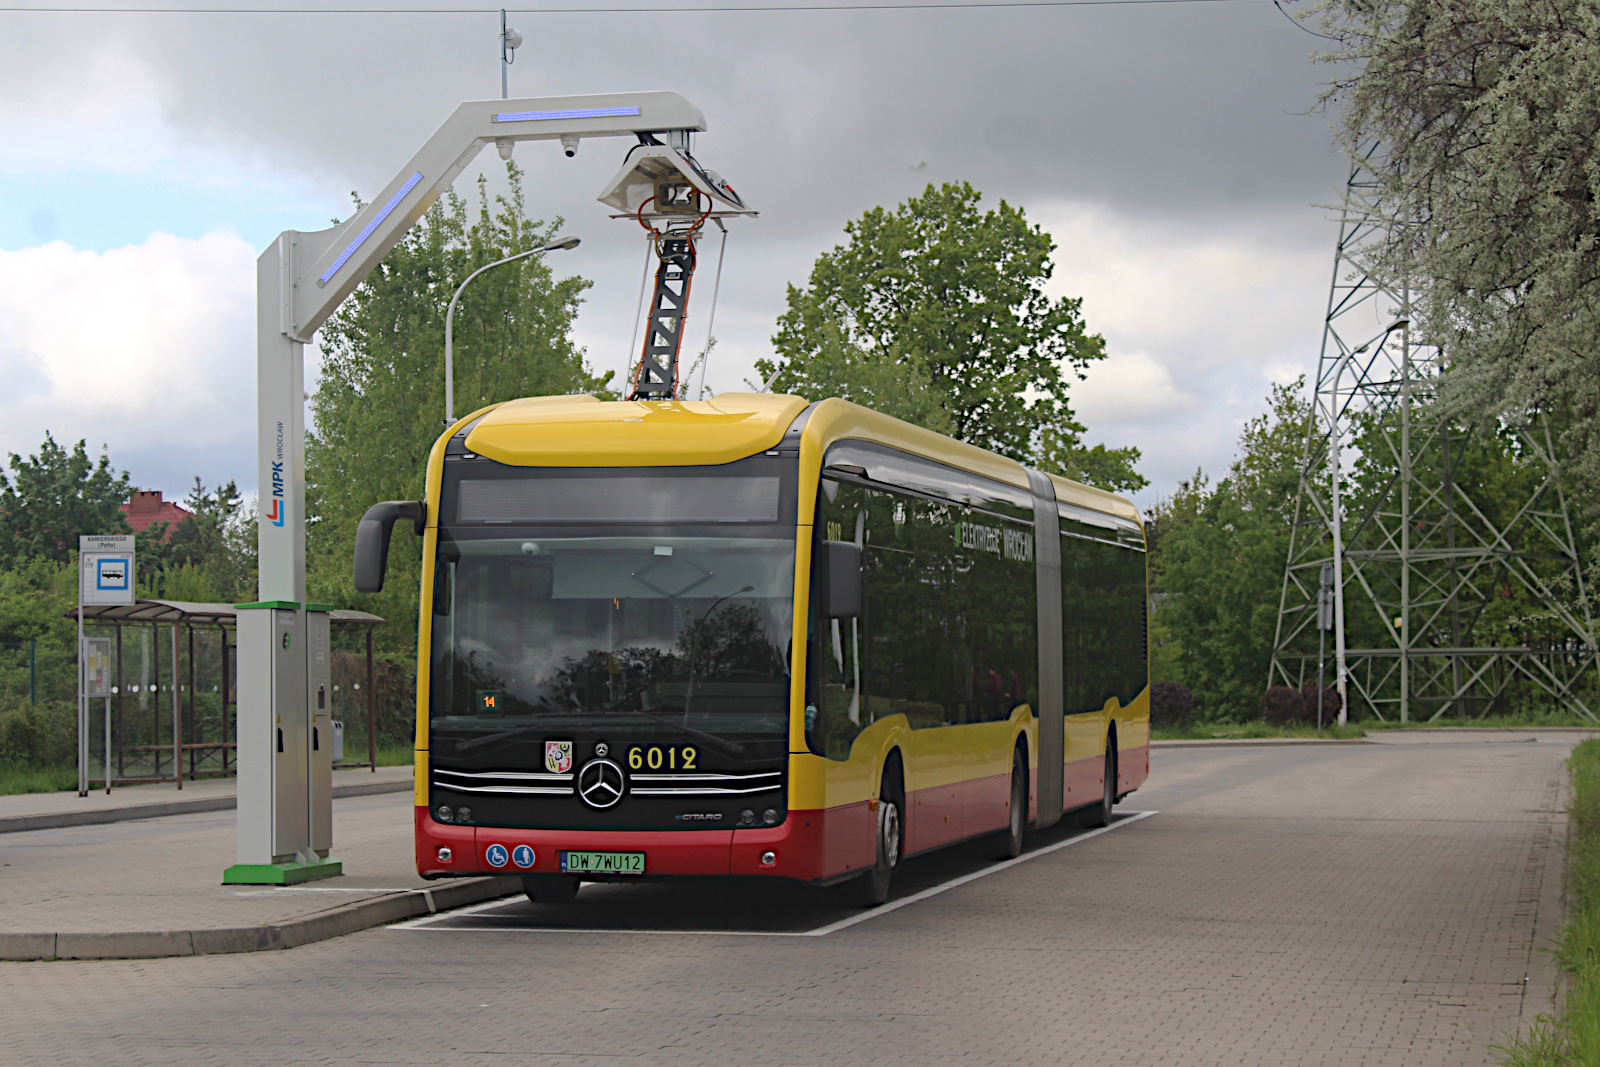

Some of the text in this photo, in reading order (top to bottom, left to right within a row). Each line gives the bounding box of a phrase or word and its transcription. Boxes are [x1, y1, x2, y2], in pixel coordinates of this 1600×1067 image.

[272, 461, 283, 497] MPK
[483, 696, 495, 707] 14
[628, 746, 696, 770] 6012
[570, 854, 640, 870] DW 7WU12
